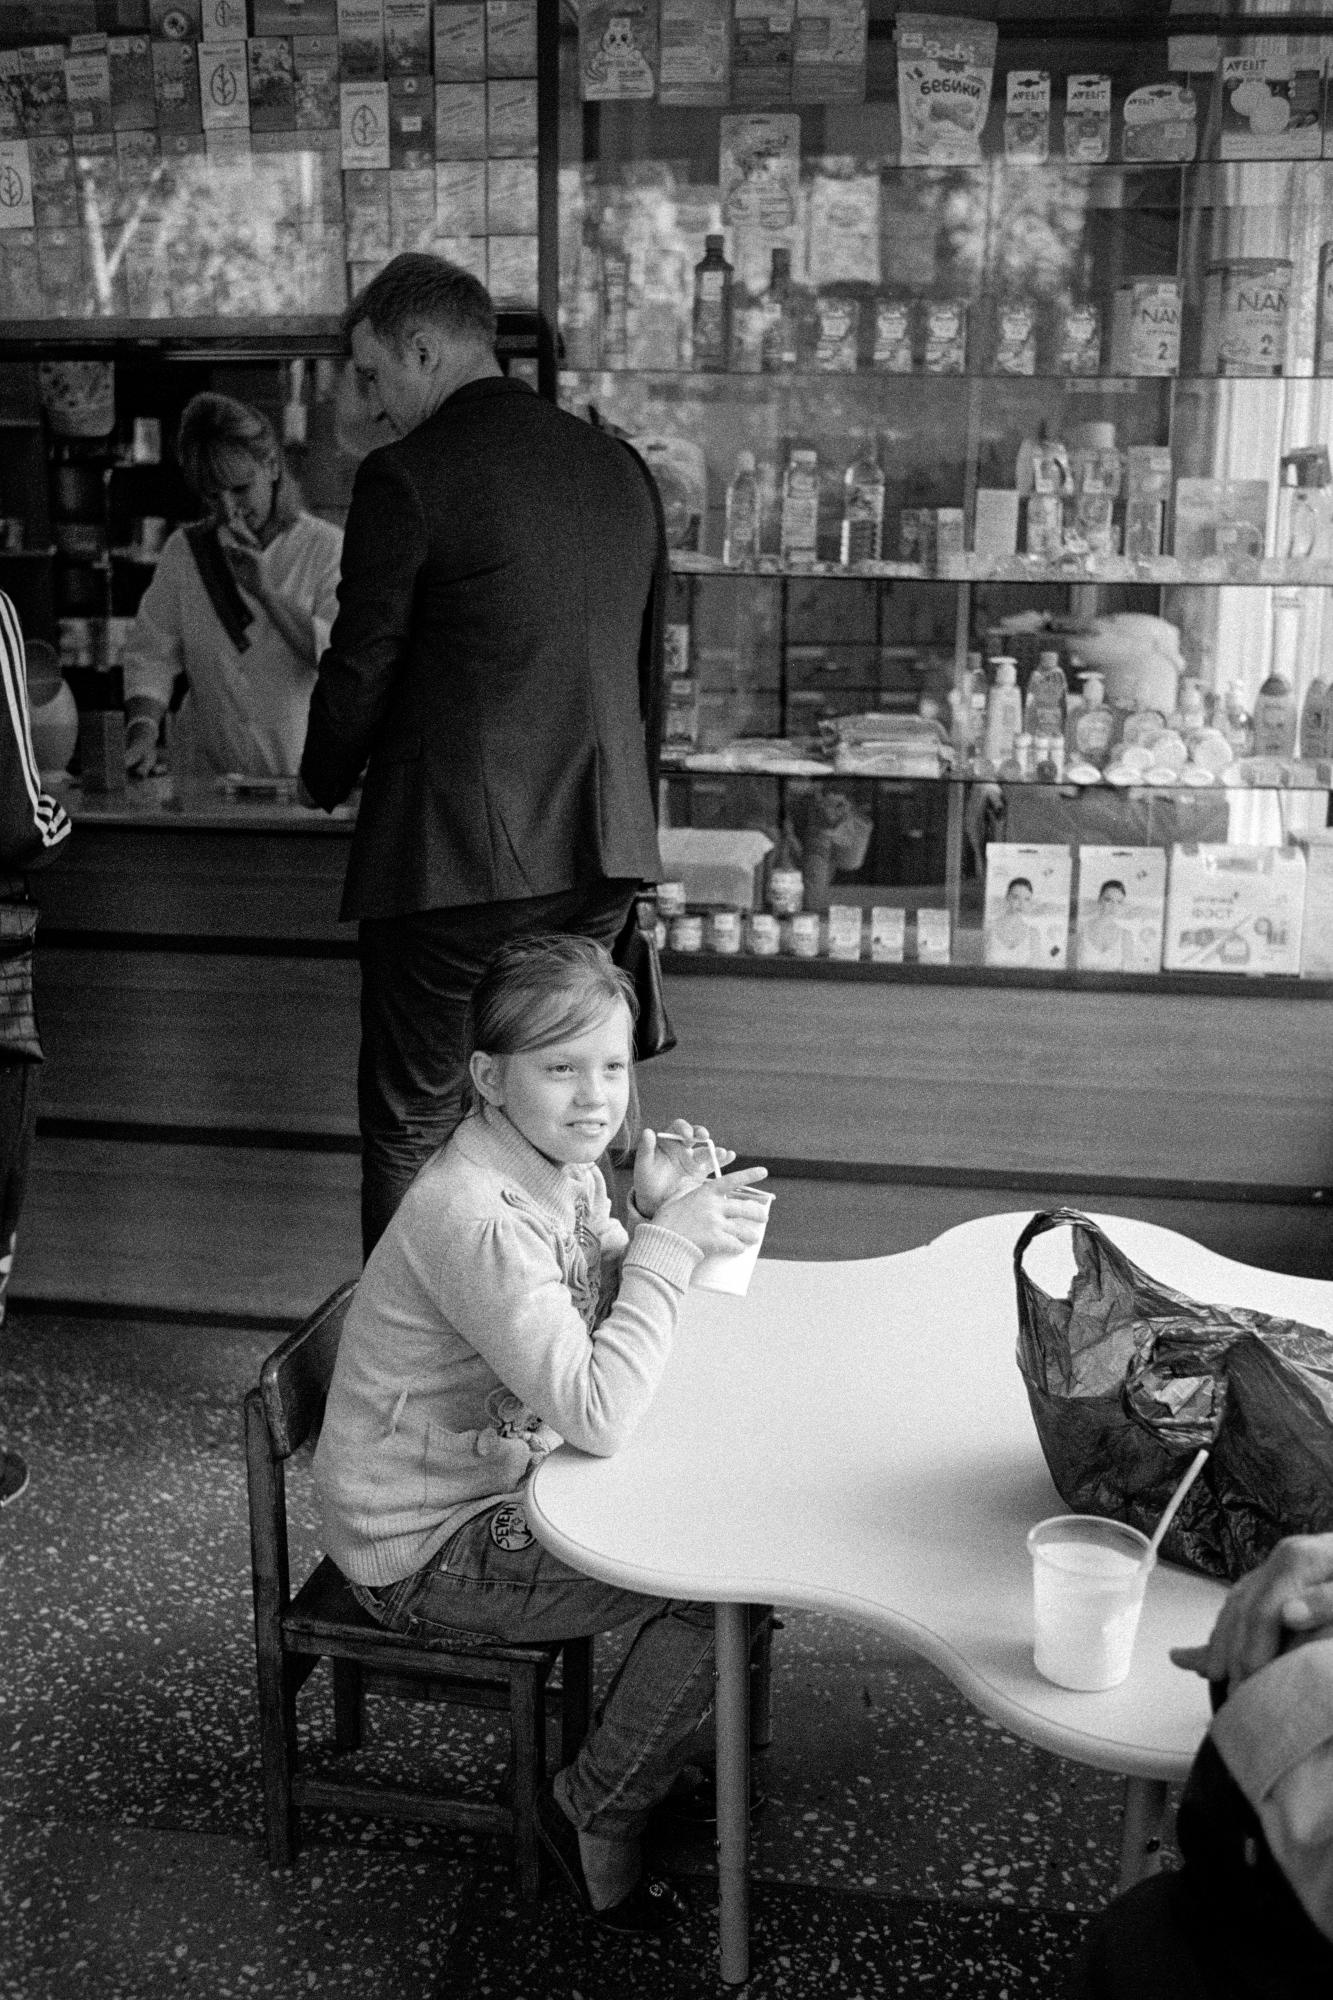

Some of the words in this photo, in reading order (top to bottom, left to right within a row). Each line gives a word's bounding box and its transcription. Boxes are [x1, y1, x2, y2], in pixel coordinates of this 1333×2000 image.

[1226, 59, 1268, 73] AVENT
[1238, 291, 1288, 312] NAN
[1142, 308, 1179, 325] NAN
[1158, 341, 1169, 360] 2
[1260, 334, 1273, 355] 2
